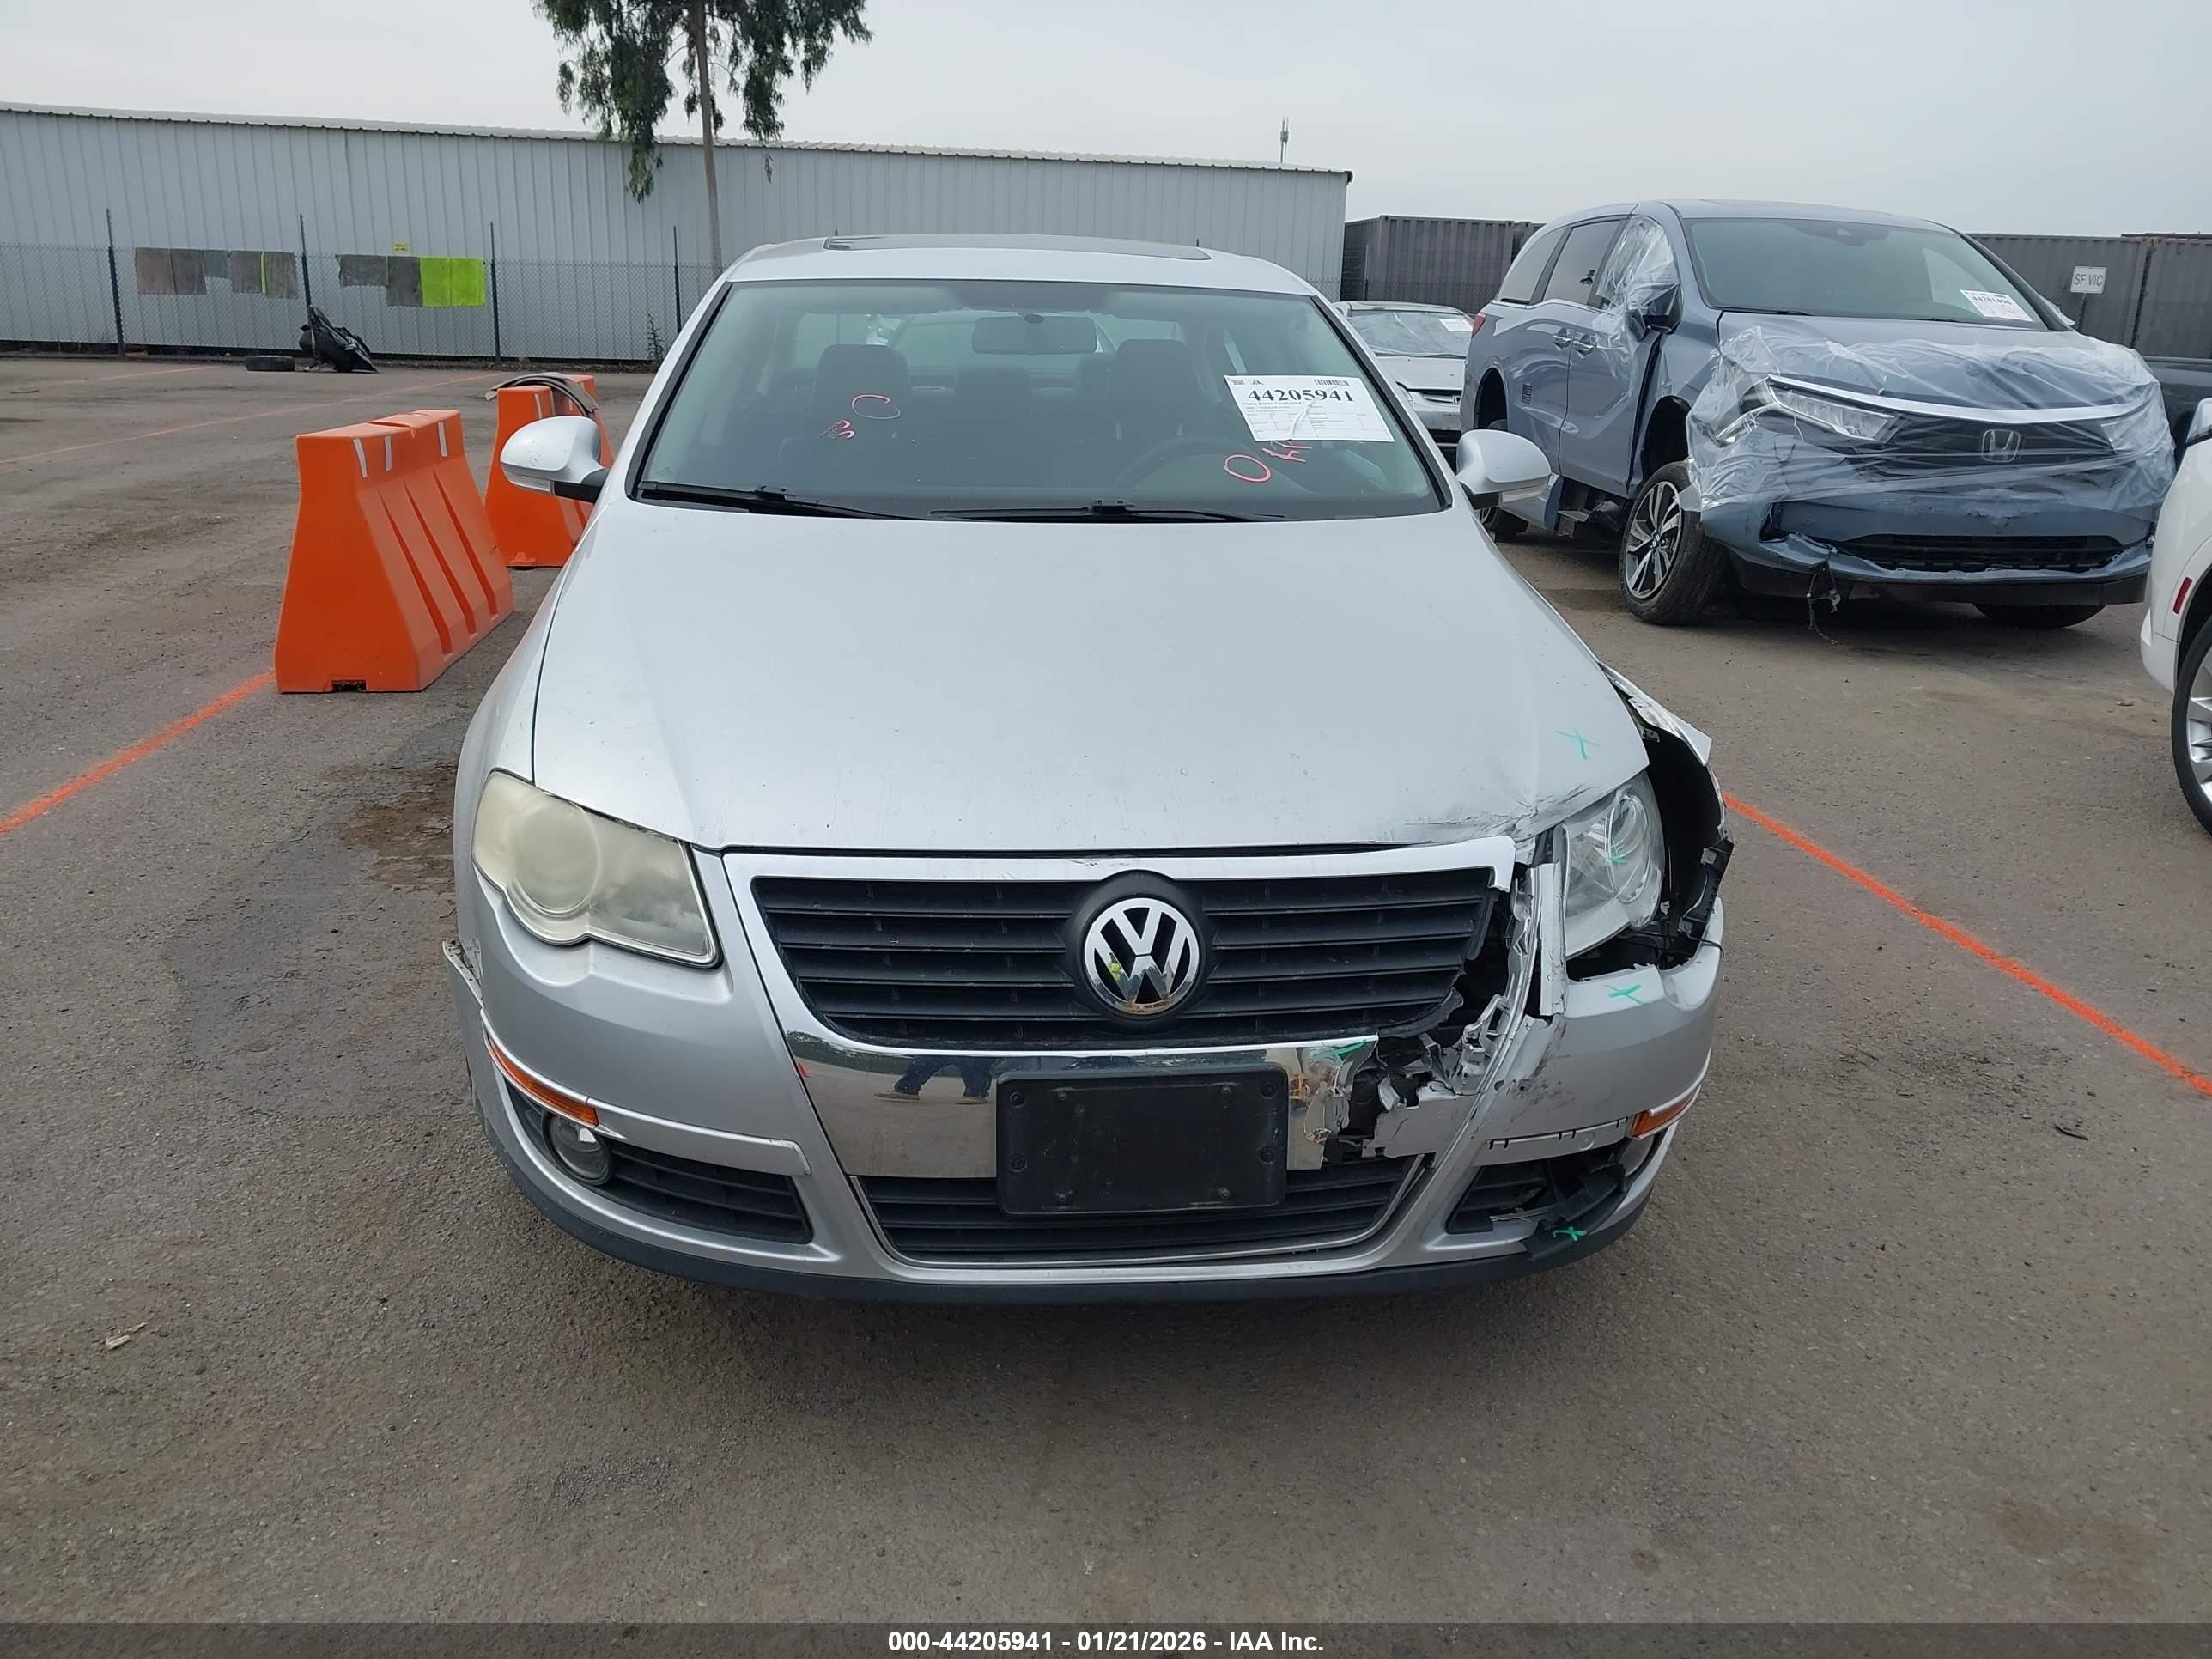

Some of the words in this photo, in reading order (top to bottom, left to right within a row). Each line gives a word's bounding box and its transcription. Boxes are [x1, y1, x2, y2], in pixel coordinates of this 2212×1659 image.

[2074, 273, 2087, 286] SF
[2087, 274, 2104, 287] VIC
[1249, 389, 1353, 402] 44205941
